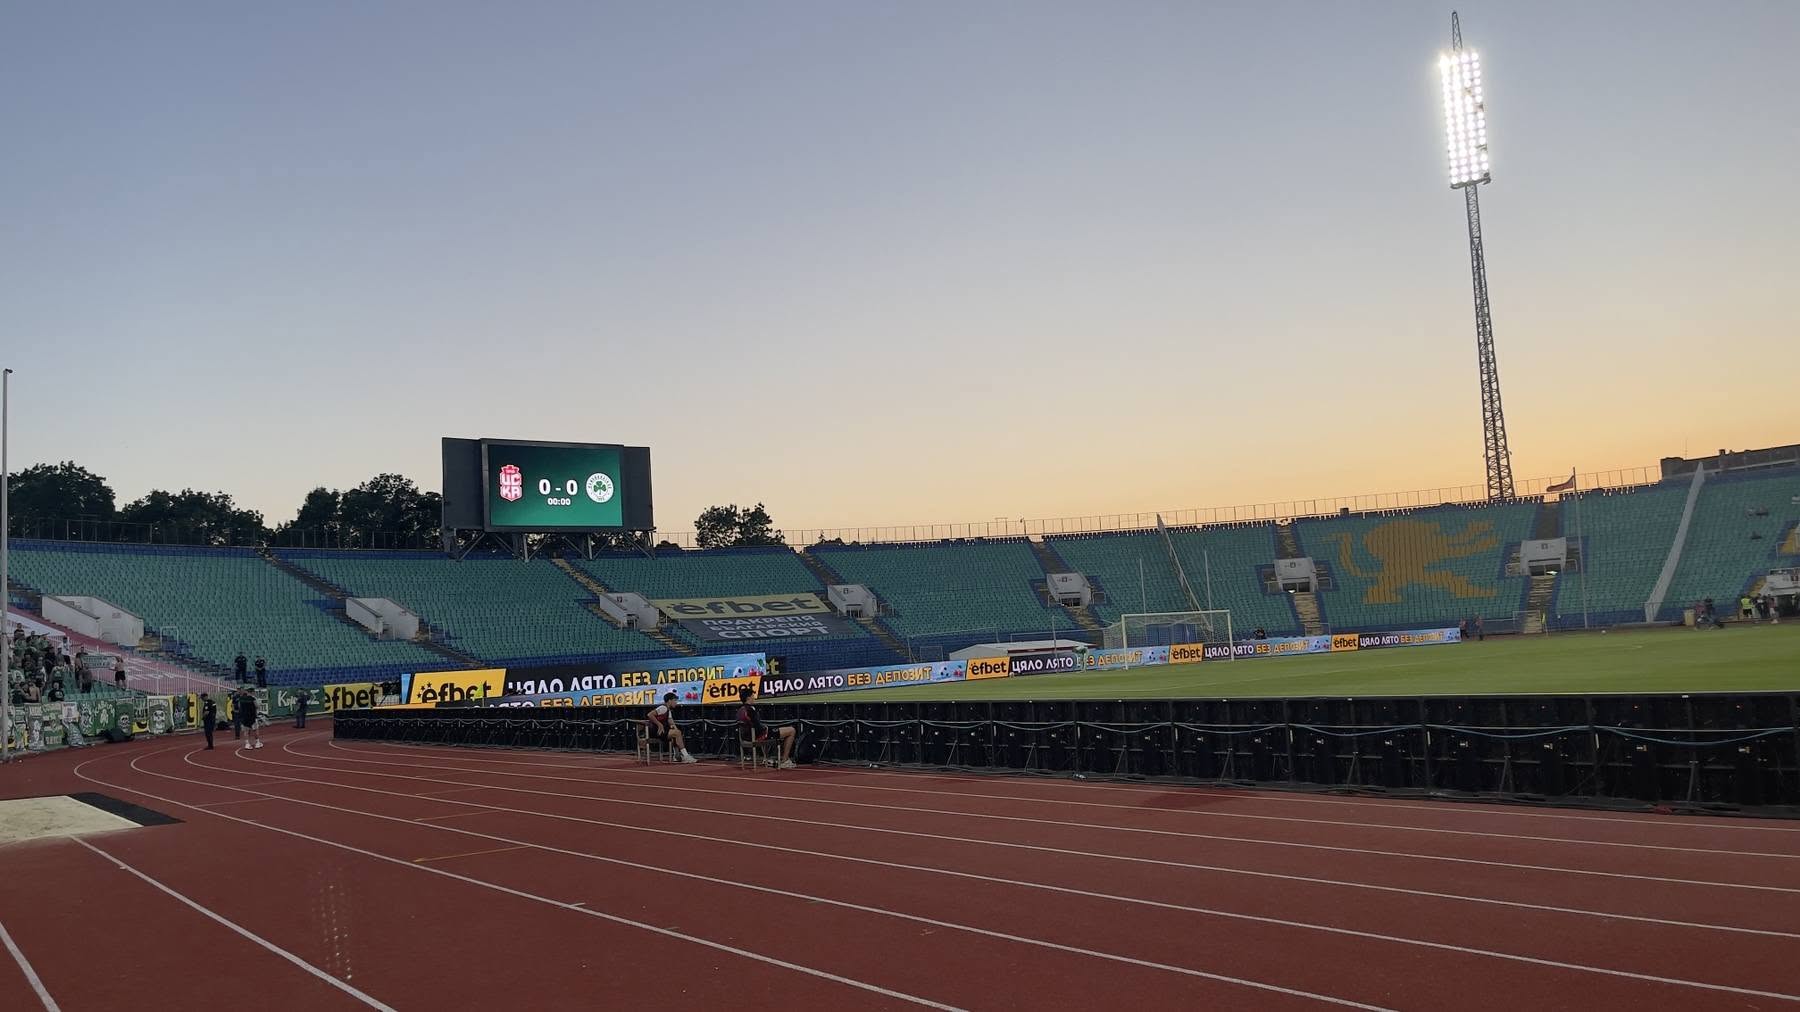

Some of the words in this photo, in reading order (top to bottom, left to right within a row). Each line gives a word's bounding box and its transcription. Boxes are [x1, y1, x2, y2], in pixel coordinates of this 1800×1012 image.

[538, 479, 551, 495] 0
[566, 480, 578, 495] 0
[672, 598, 819, 614] efbet
[717, 625, 830, 639] СПОРТ
[1334, 636, 1357, 648] efbet
[1172, 648, 1201, 661] efbet
[972, 661, 1007, 675] efbet
[1012, 659, 1043, 673] ЦЯЛО
[1045, 657, 1074, 671] ЛЯТО
[763, 678, 804, 694] ЦЯЛО
[808, 675, 844, 691] ЛЯТО
[848, 673, 872, 687] БЕЗ
[874, 667, 932, 684] ДЕПОЗИТ
